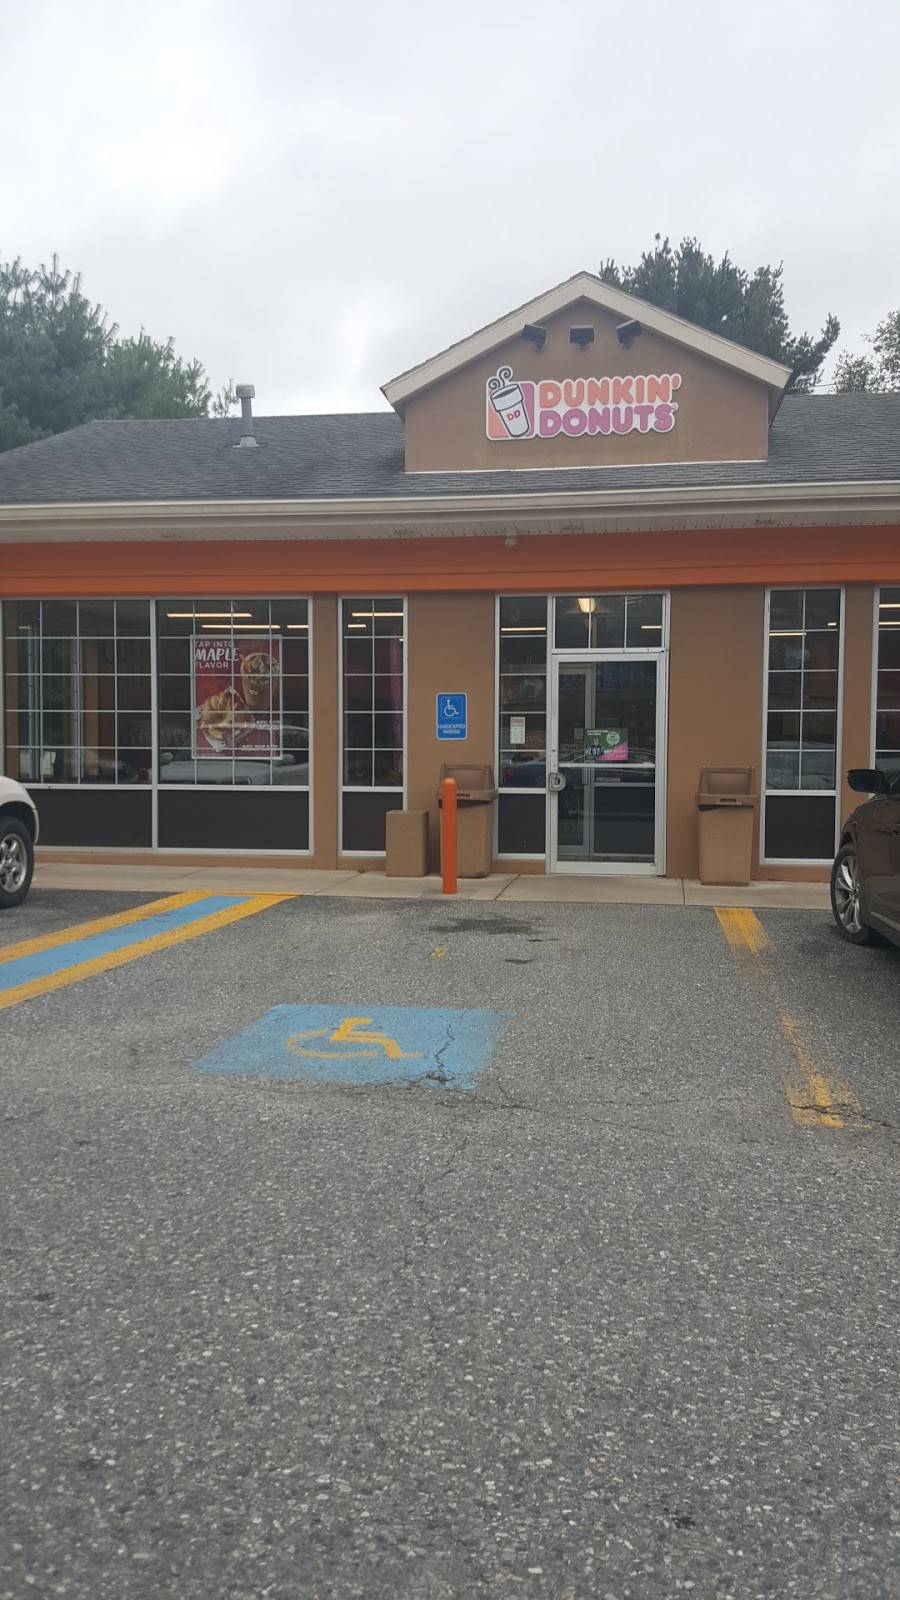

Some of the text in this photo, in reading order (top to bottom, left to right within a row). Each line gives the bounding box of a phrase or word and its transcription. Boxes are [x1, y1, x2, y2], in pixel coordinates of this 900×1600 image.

[539, 374, 681, 407] DUNKIN'
[507, 409, 521, 421] DD
[539, 404, 674, 436] DONUTS
[213, 640, 235, 648] INTO
[194, 648, 240, 662] MAPLE
